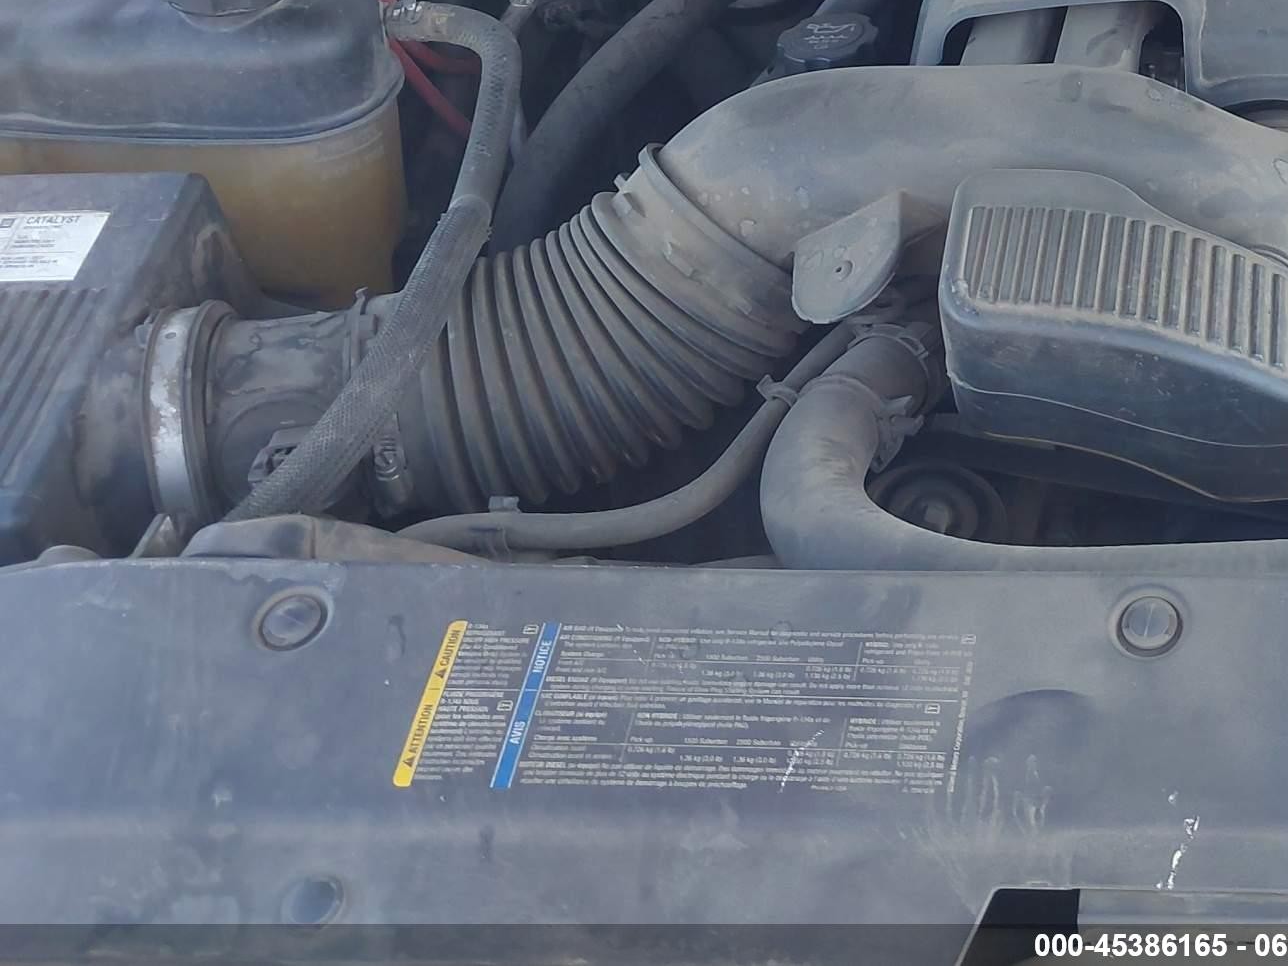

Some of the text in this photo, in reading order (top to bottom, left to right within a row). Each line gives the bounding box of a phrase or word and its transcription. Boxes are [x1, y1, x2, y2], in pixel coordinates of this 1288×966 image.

[26, 216, 81, 224] CATALYST
[440, 629, 461, 666] CAUTION
[532, 640, 552, 673] NOTICE
[408, 703, 433, 753] ATTENTION
[510, 721, 526, 744] AVIS
